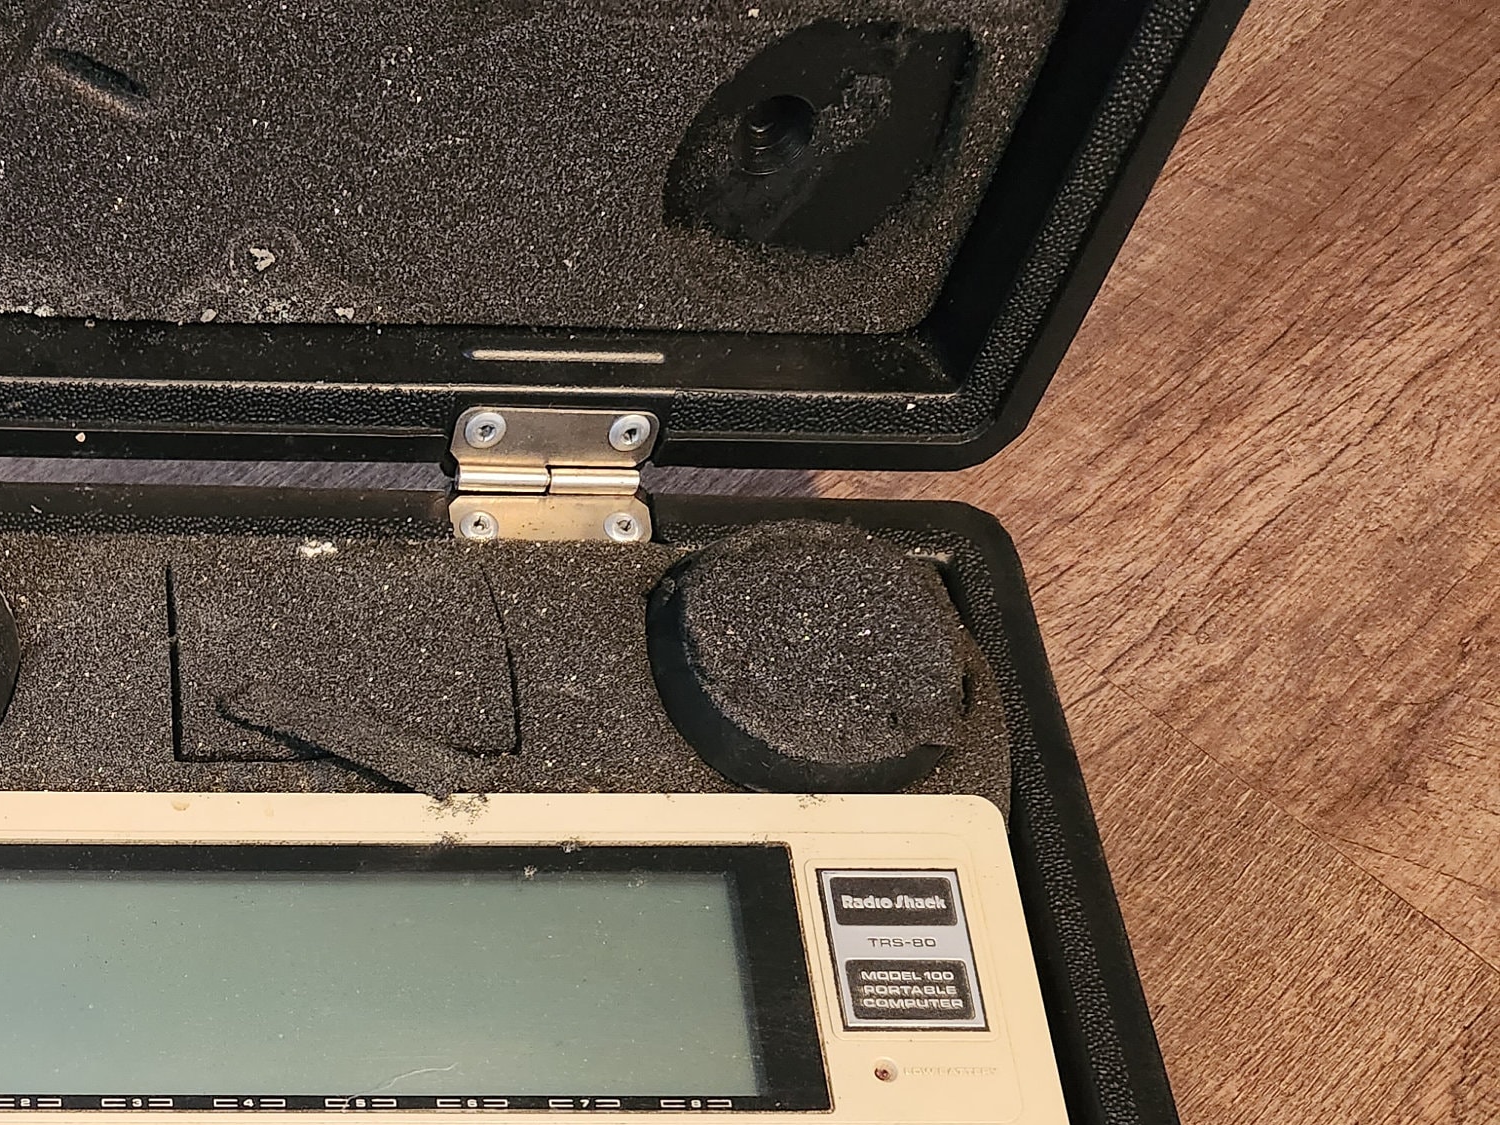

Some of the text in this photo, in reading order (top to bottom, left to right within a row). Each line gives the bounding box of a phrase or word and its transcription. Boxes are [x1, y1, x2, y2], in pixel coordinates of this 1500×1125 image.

[841, 894, 947, 910] Radio Shack
[867, 937, 937, 948] TRS-80
[861, 971, 955, 982] MODEL 100
[863, 985, 957, 996] PORTABLE
[863, 998, 964, 1010] COMPUTER
[20, 1098, 31, 1107] 2
[132, 1098, 143, 1108] 3
[243, 1098, 254, 1108] 4
[355, 1098, 366, 1108] 5
[467, 1098, 478, 1108] 6
[579, 1099, 590, 1108] 7
[690, 1099, 702, 1108] 8
